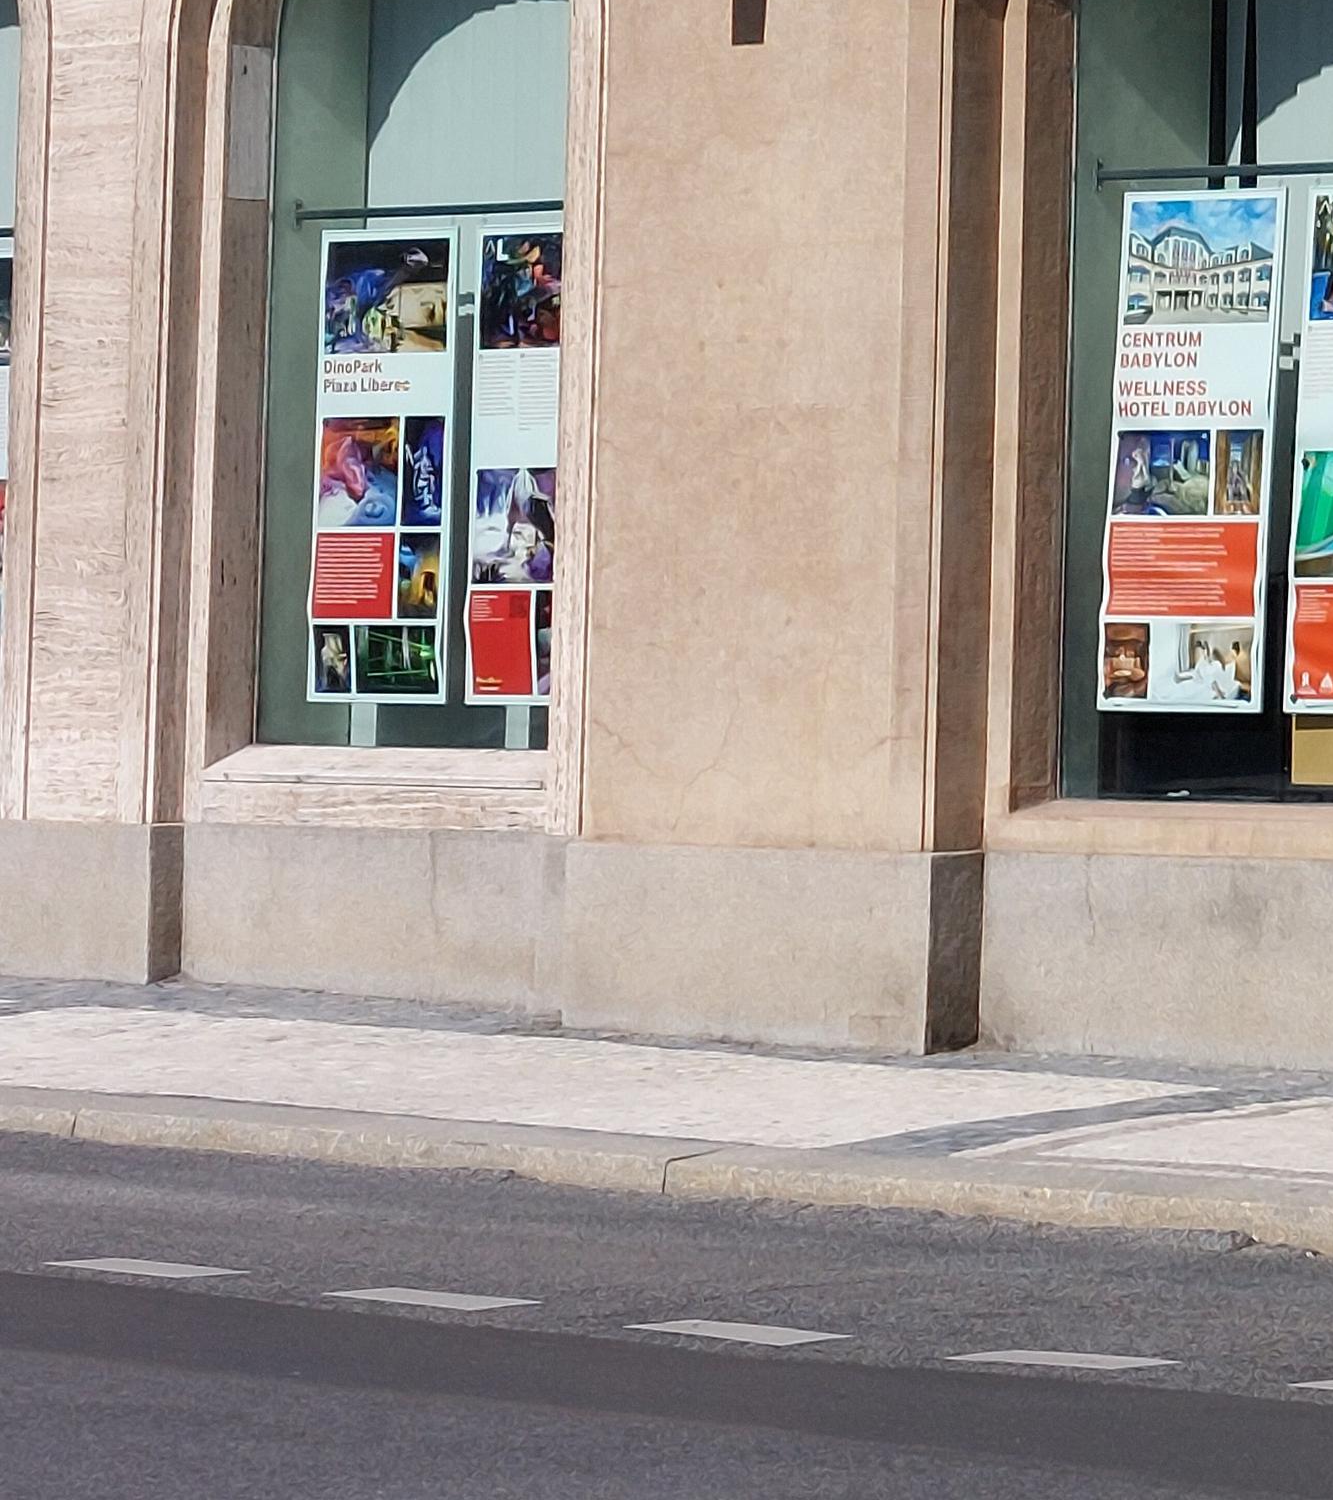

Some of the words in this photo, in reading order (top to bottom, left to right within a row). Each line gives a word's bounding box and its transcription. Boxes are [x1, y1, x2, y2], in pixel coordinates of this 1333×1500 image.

[1121, 331, 1202, 348] CENTRUM
[323, 358, 382, 374] DinoPark
[1120, 352, 1198, 368] BABYLON
[323, 379, 357, 393] Plaza
[360, 377, 410, 392] Liberec
[1118, 379, 1208, 396] WELLNESS
[1118, 400, 1170, 417] HOTEL
[1175, 399, 1252, 417] BABYLON
